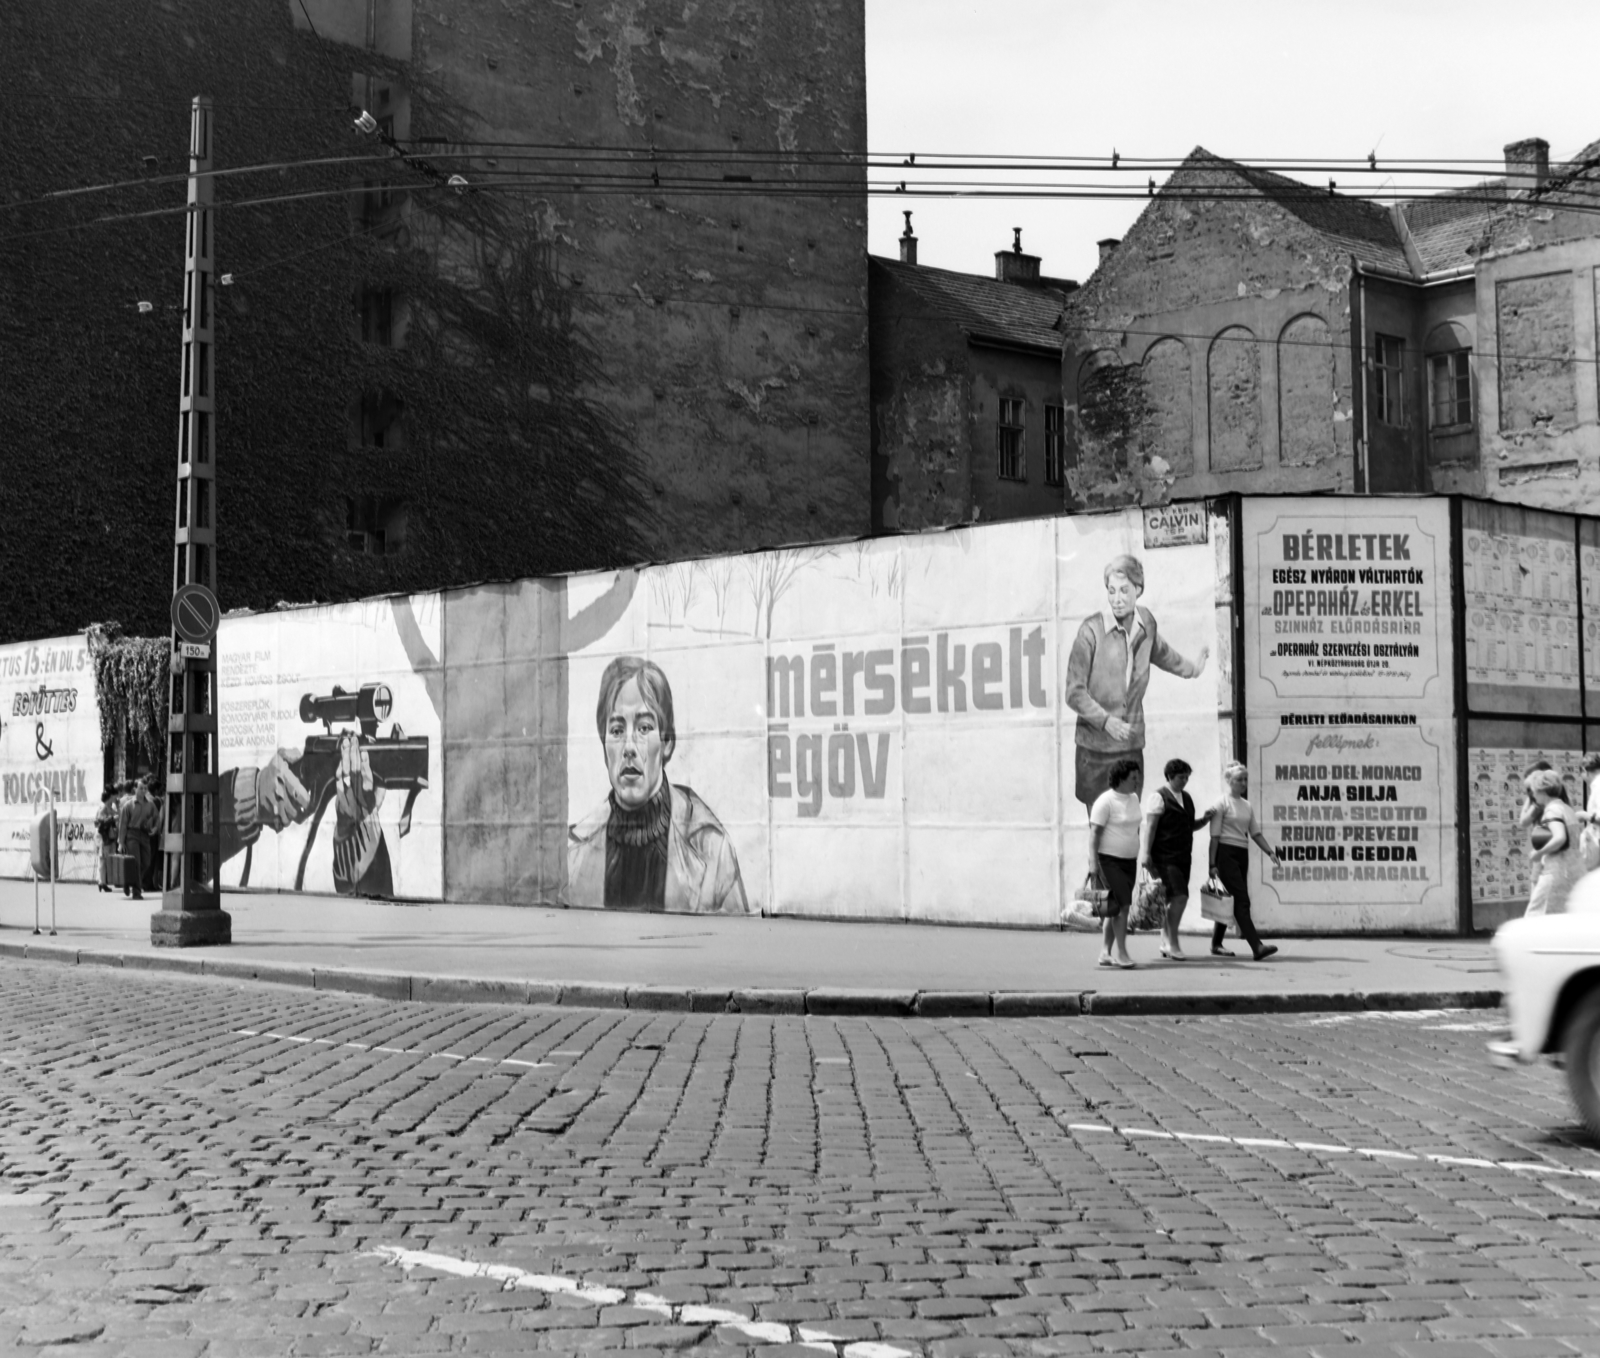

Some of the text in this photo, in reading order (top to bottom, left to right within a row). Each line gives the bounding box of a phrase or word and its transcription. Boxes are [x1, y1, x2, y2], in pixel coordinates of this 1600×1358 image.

[1149, 513, 1199, 530] CALVIN
[1282, 529, 1411, 561] BÉRLETEK
[1272, 566, 1423, 584] EGÉSZ NYÁRON VÁLTHATÓK
[1360, 601, 1371, 616] és
[1371, 590, 1423, 617] ERKEL
[1274, 618, 1324, 634] SZINHÁZ
[186, 645, 200, 656] 150
[221, 650, 271, 663] MAGYAR FILM
[1277, 640, 1319, 657] OPERAHÁZ
[1322, 641, 1370, 657] SZERVEZÉSI
[1373, 642, 1419, 657] OSZTÁLYÁN
[0, 655, 22, 677] TUS
[12, 684, 79, 717] EGYÜTTES
[1281, 712, 1417, 725] BÉRLETI ELŐADÁSAINKON
[256, 723, 275, 734] MARI
[35, 721, 54, 761] &
[1275, 765, 1422, 781] MARIO DEL MONACO
[1297, 785, 1398, 801] ANJA SILJA
[1273, 805, 1427, 821] RENATA SCOTTO
[1343, 826, 1419, 842] PREVEDI
[1275, 846, 1417, 862] NICOLAI GEDDA
[1272, 866, 1429, 882] GIACOMO ARAGALL
